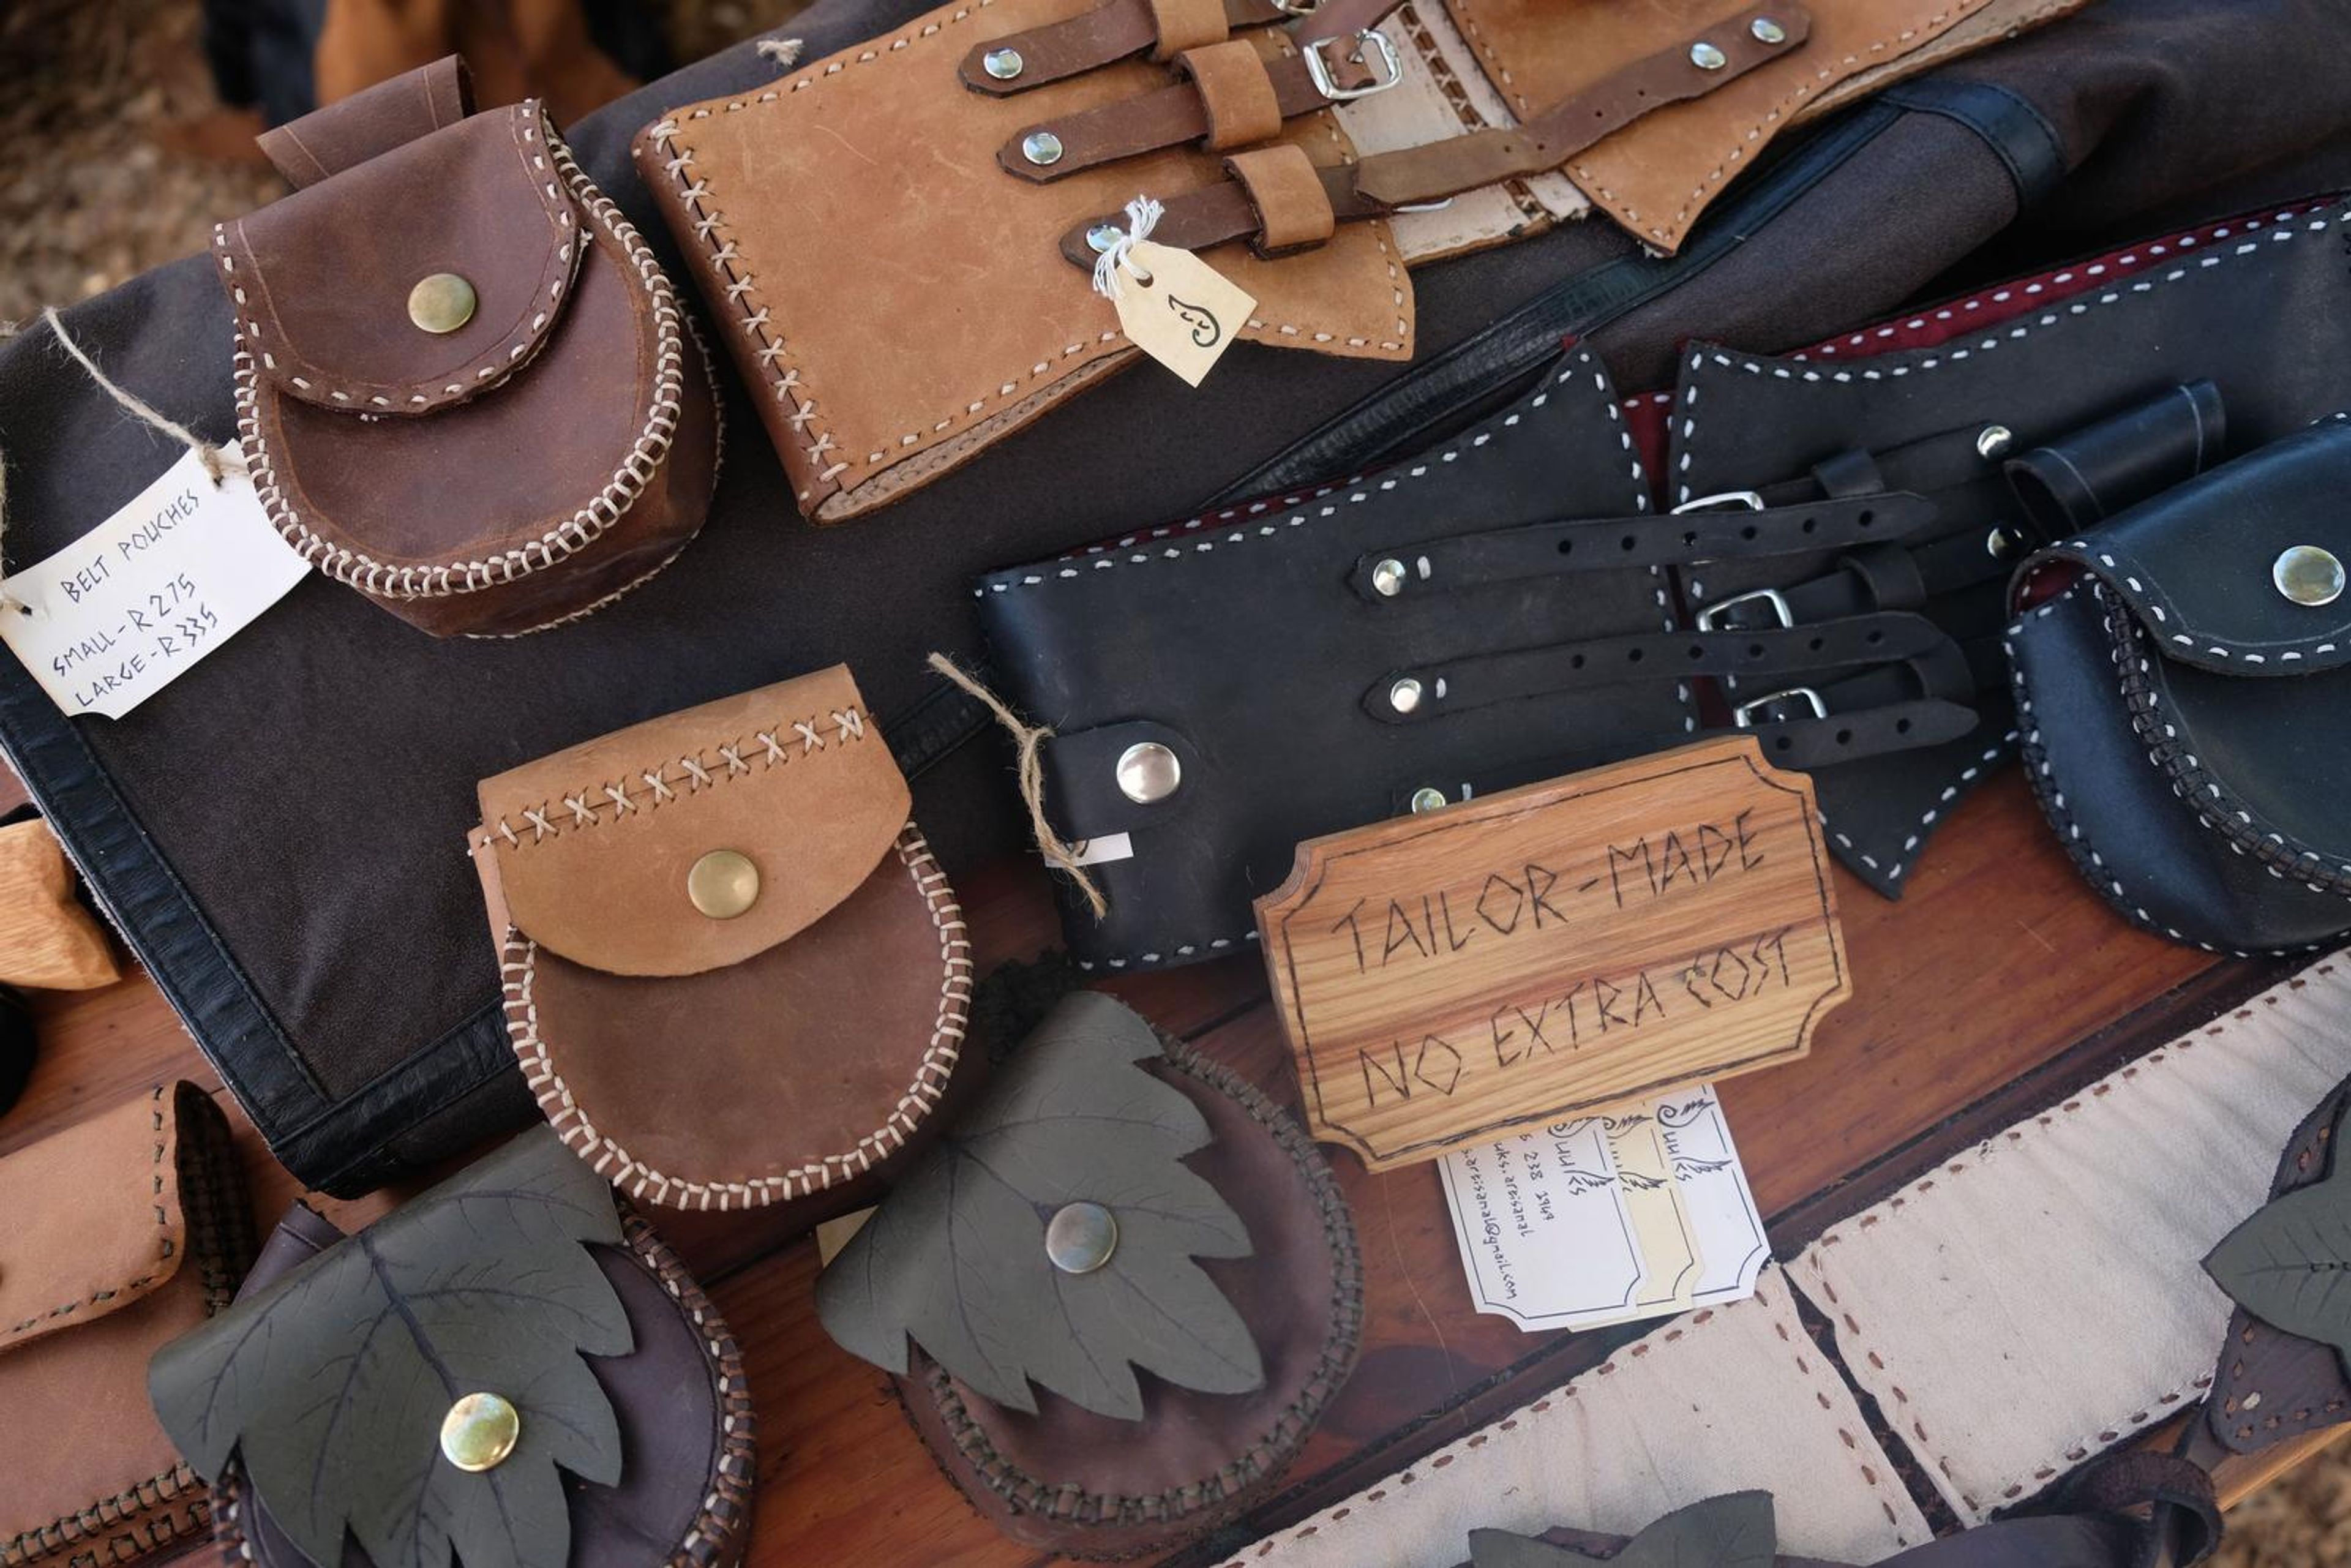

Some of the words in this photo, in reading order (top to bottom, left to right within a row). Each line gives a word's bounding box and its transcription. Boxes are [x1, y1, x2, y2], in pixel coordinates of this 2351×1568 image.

[61, 555, 111, 604] BELT
[118, 488, 200, 561] POUCHES
[1330, 806, 1765, 974] TAILOR-MADE
[1358, 1033, 1463, 1108] NO
[1491, 972, 1667, 1068] EXTRA
[1684, 925, 1794, 1009] COST
[1461, 1149, 1518, 1300] s.artisanal@gmail.com
[1524, 1152, 1544, 1181] 238
